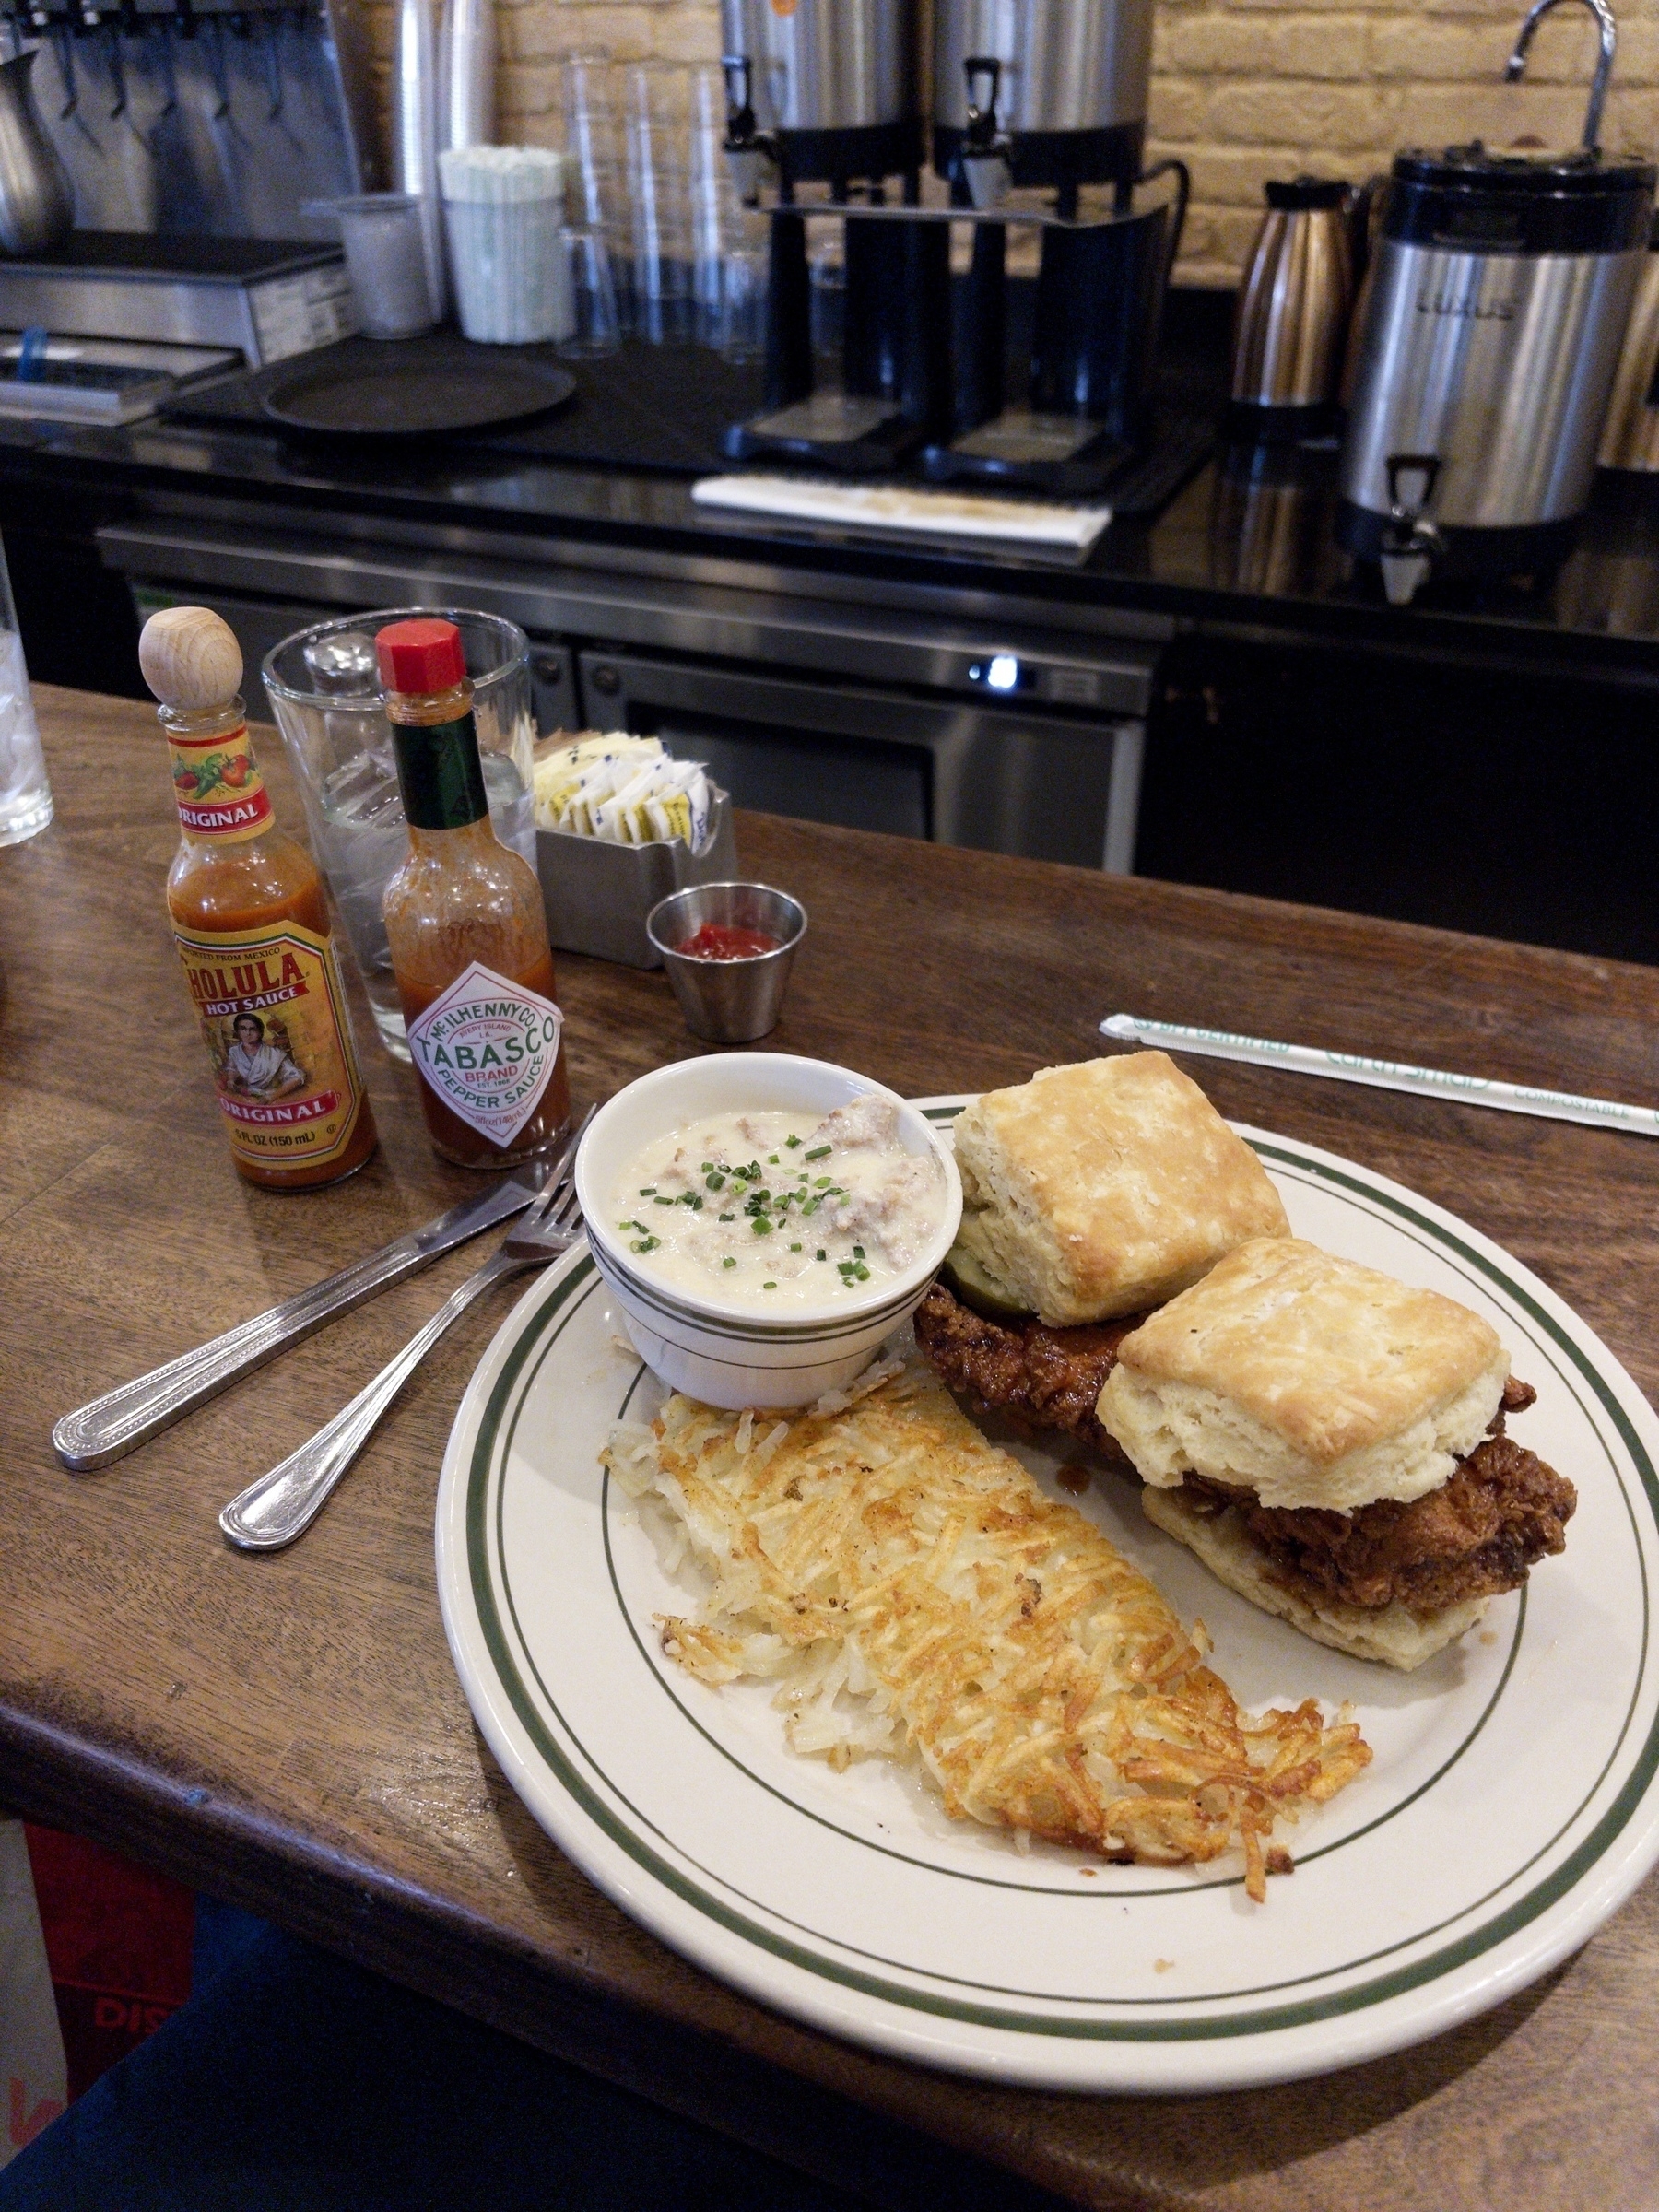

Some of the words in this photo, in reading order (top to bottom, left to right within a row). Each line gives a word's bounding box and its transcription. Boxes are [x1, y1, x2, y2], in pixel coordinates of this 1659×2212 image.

[216, 952, 242, 963] FROM
[245, 947, 281, 961] MEXICO
[206, 1000, 240, 1015] HOT
[245, 986, 299, 1011] SAUCE
[416, 1015, 555, 1071] TABASCO
[459, 1024, 482, 1039] AVERY
[484, 1022, 512, 1032] ISLAND
[437, 1069, 500, 1109] PEPPER
[504, 1054, 544, 1105] SAUCE
[465, 1065, 518, 1083] BRAND
[219, 1097, 326, 1123] ORIGINAL
[1514, 1087, 1630, 1119] COMPOSTABLE
[269, 1134, 293, 1147] (150
[294, 1130, 316, 1145] mL)
